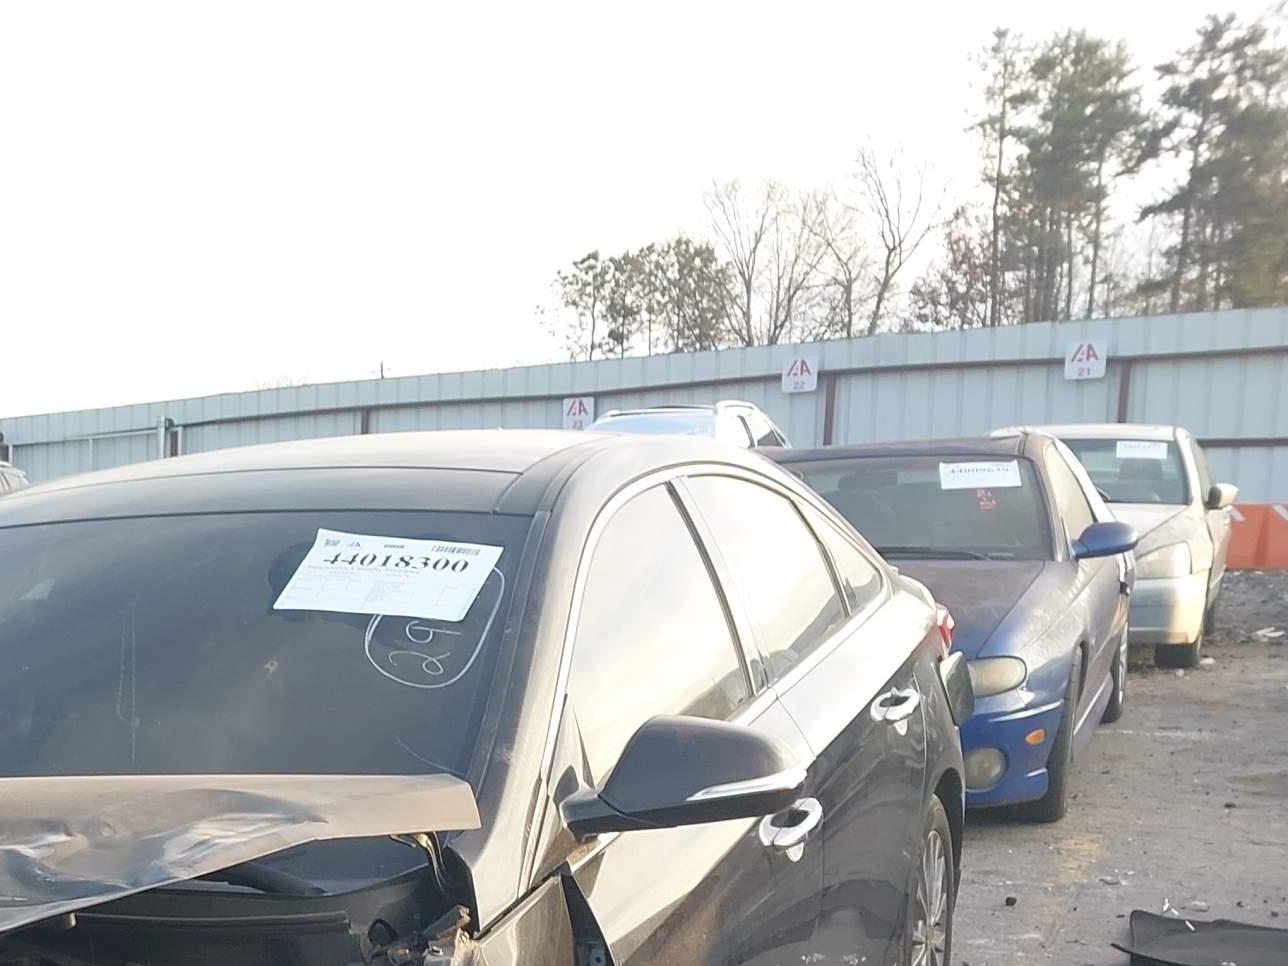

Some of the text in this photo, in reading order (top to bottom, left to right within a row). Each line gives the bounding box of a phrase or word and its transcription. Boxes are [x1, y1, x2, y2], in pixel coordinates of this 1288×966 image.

[1077, 367, 1090, 377] 21
[793, 381, 806, 390] 22
[323, 552, 469, 573] 44018300
